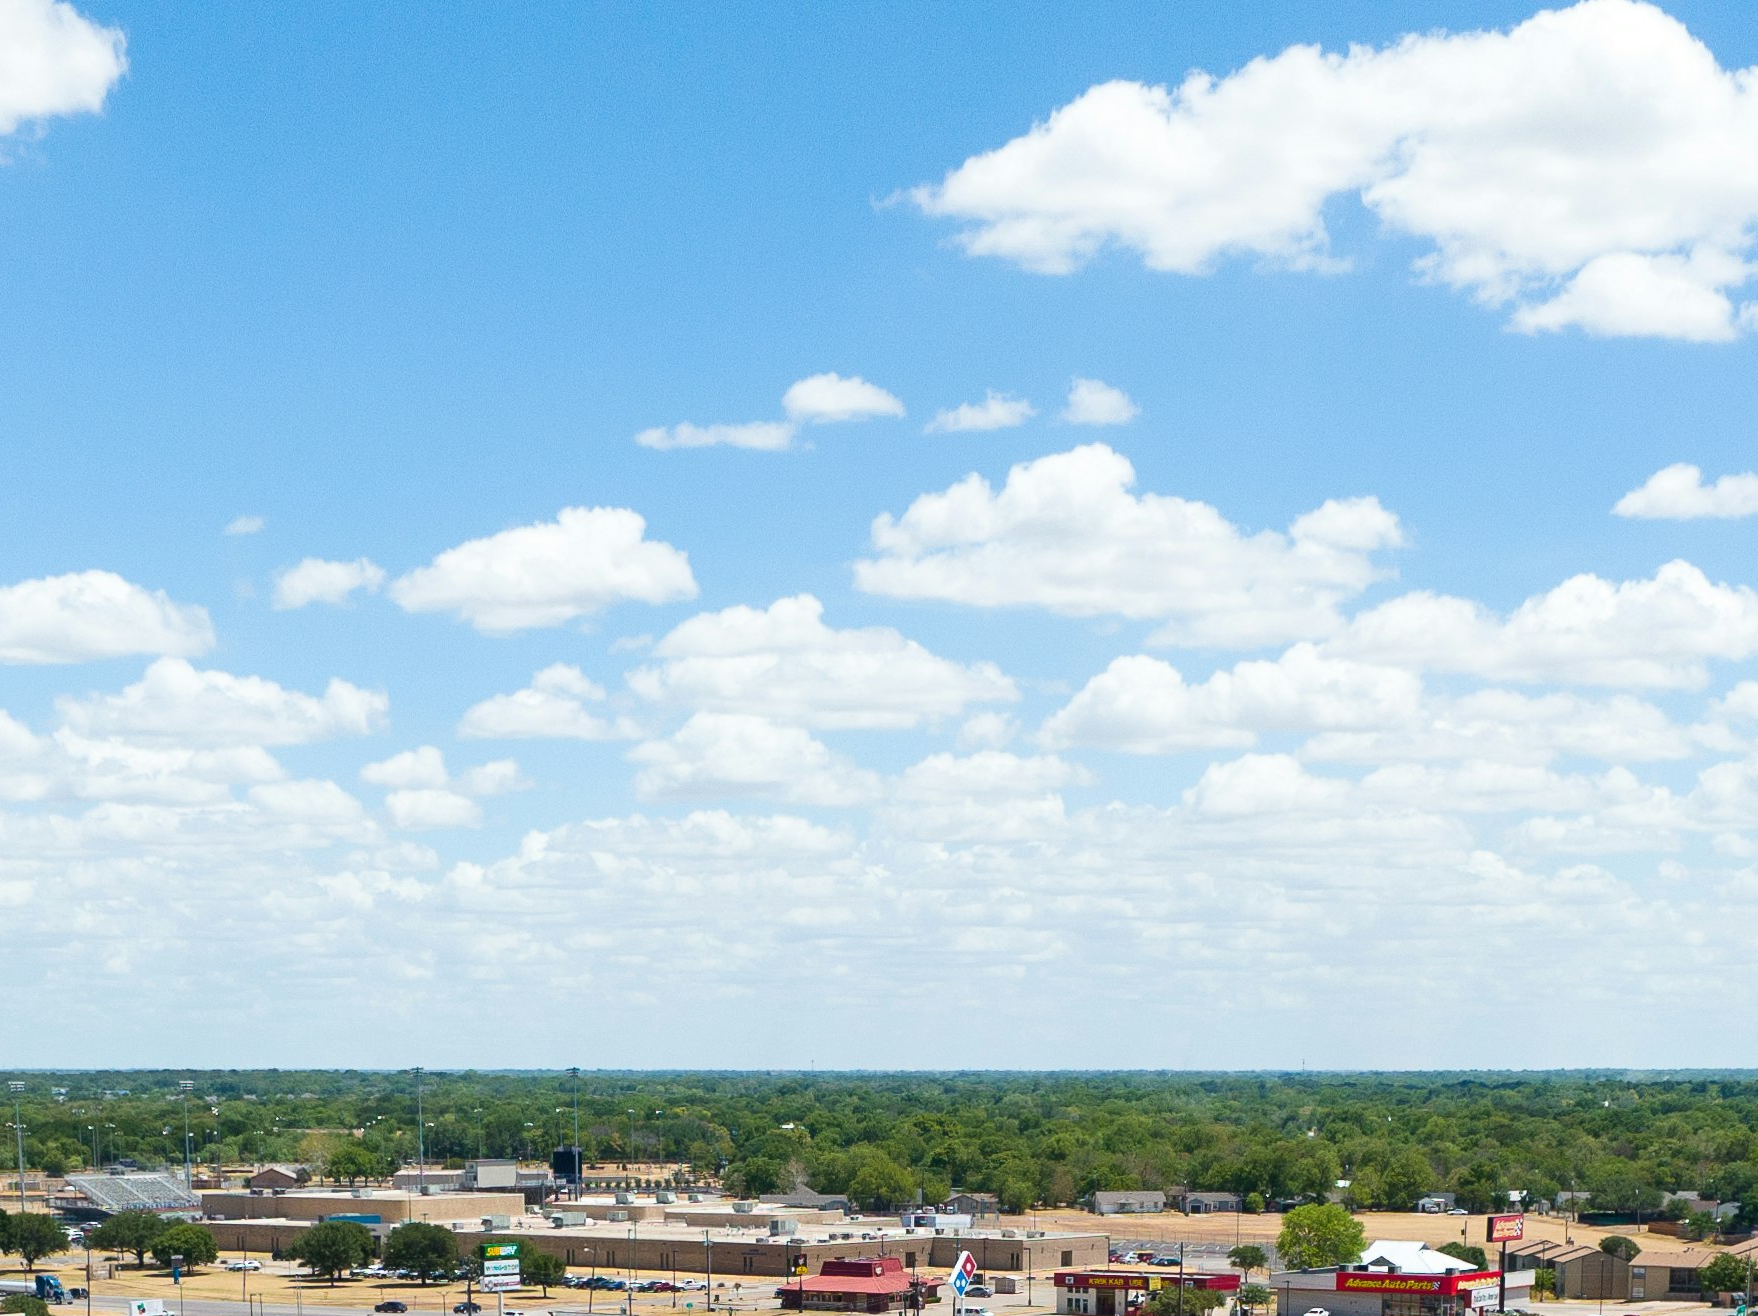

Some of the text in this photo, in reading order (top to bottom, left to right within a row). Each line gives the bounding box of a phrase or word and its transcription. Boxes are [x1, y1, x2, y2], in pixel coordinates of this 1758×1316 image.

[1345, 1278, 1432, 1290] Advance Auto Parts
